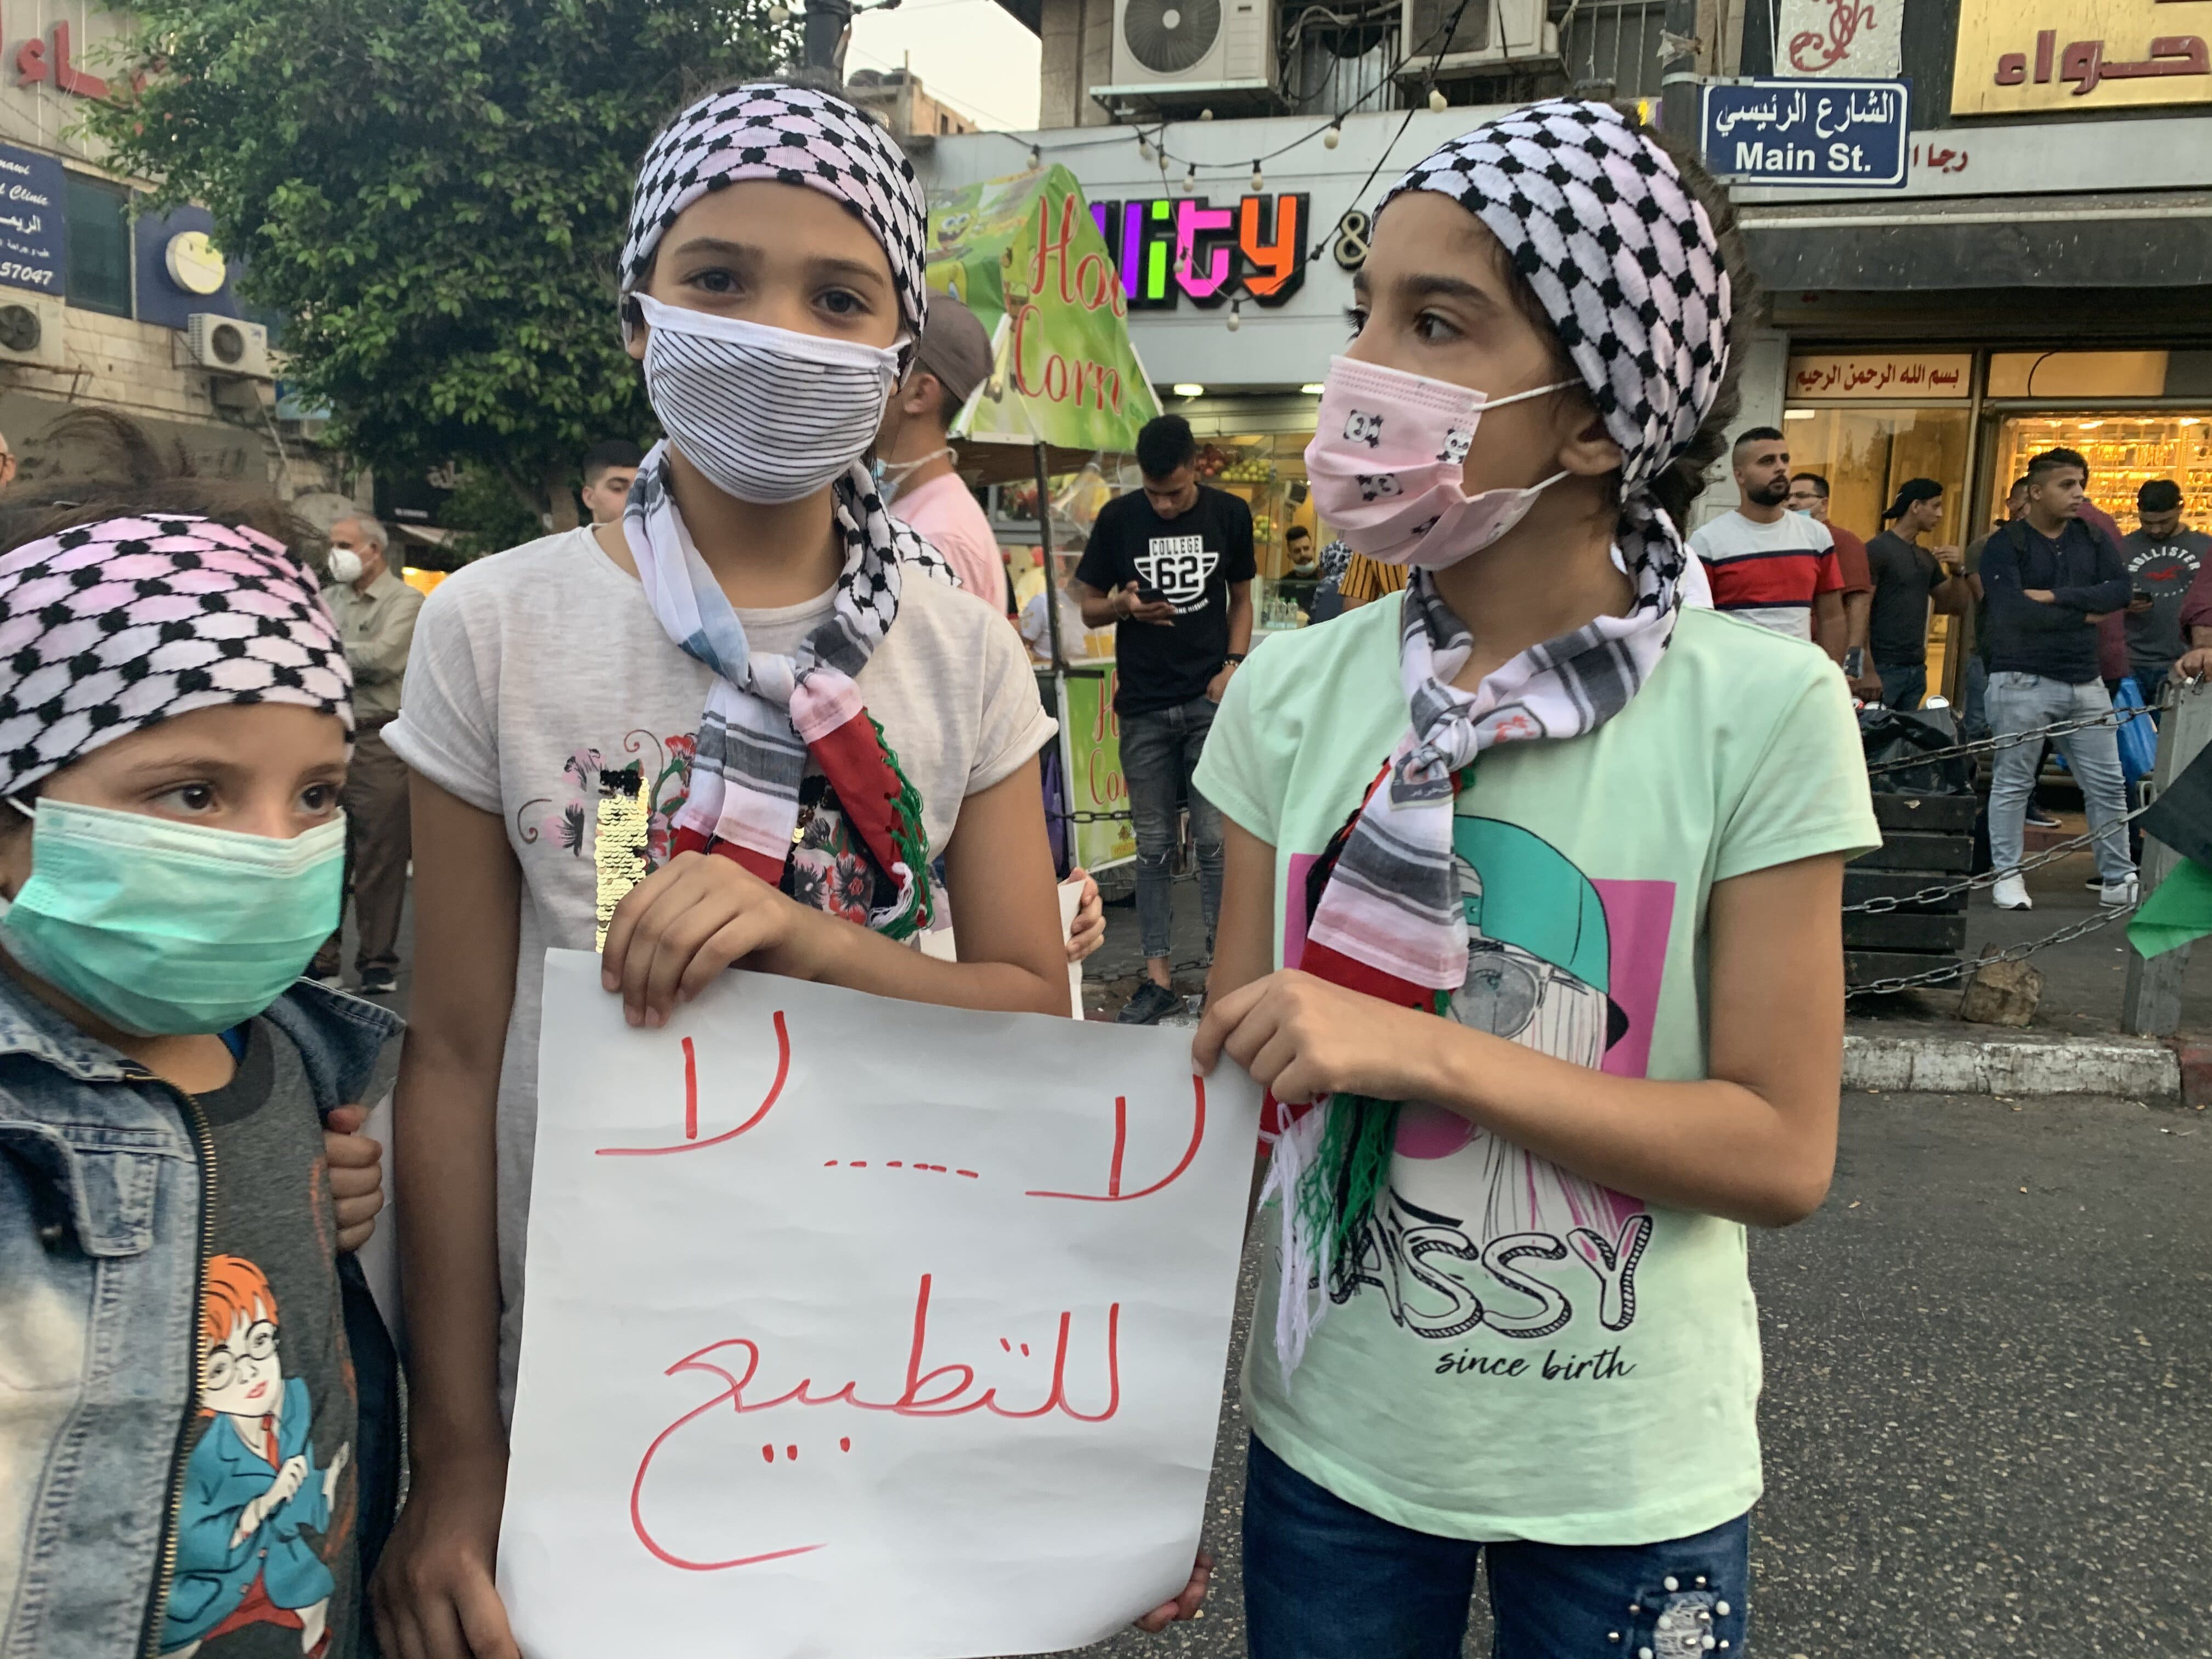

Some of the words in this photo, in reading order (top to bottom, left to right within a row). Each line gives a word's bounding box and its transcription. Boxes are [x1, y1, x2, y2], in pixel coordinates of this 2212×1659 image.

[1994, 30, 2211, 96] حواء
[1716, 89, 1807, 138] الرئيسي
[1816, 89, 1894, 139] الشارع
[1735, 142, 1815, 172] Main
[1827, 142, 1872, 172] St.
[9, 184, 48, 205] Clinic
[1014, 304, 1125, 414] Corn
[1900, 363, 1925, 384] الله
[1796, 364, 1841, 392] الرحيم
[1843, 363, 1895, 391] الرحمن
[1928, 368, 1959, 391] بسم
[1152, 537, 1200, 555] COLLEGE
[2128, 546, 2201, 572] HOLLISTER
[1156, 556, 1199, 590] 62
[595, 1010, 791, 1155] لا
[1024, 1074, 1206, 1201] لا
[1274, 1214, 1652, 1339] ASSY
[1435, 1347, 1530, 1376] since
[1541, 1345, 1637, 1380] birth
[630, 1273, 1120, 1571] للتطبيع
